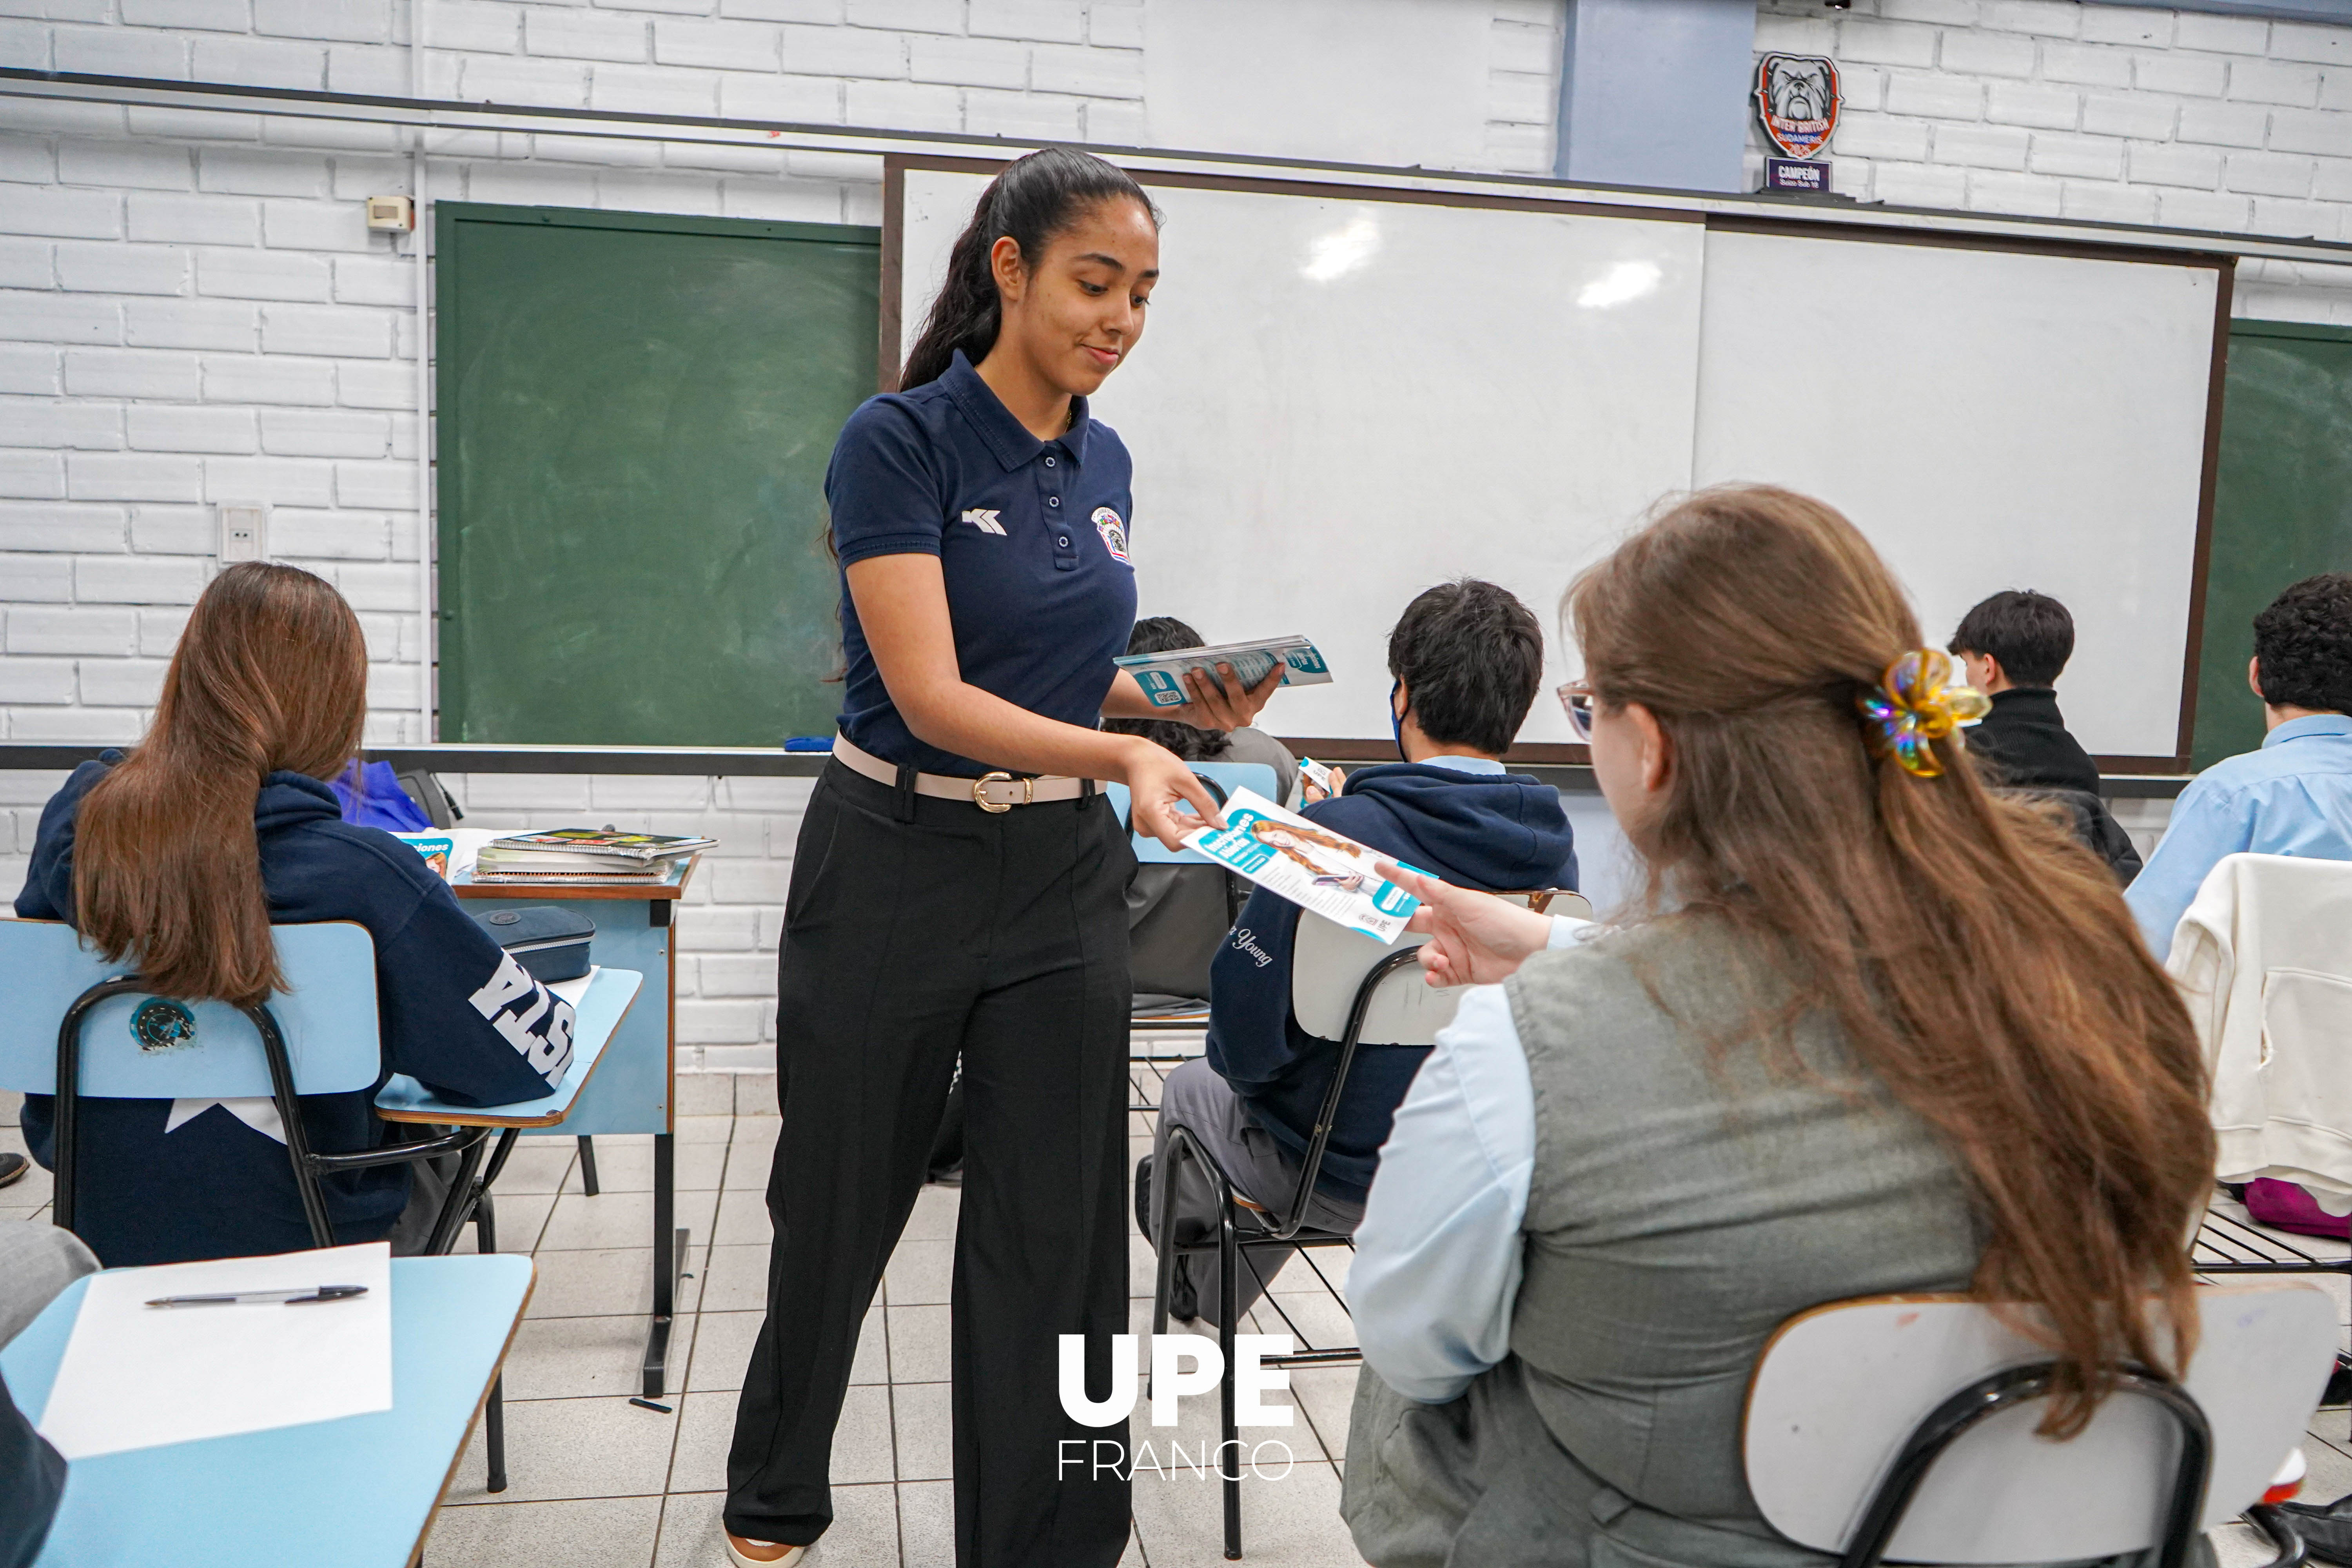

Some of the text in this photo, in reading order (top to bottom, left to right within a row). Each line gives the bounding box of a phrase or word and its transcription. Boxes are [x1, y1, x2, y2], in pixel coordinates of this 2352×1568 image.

[1778, 165, 1820, 181] CAMPEÓN
[1797, 180, 1811, 188] Sub
[1376, 920, 1391, 932] UPE
[1232, 929, 1273, 967] Young
